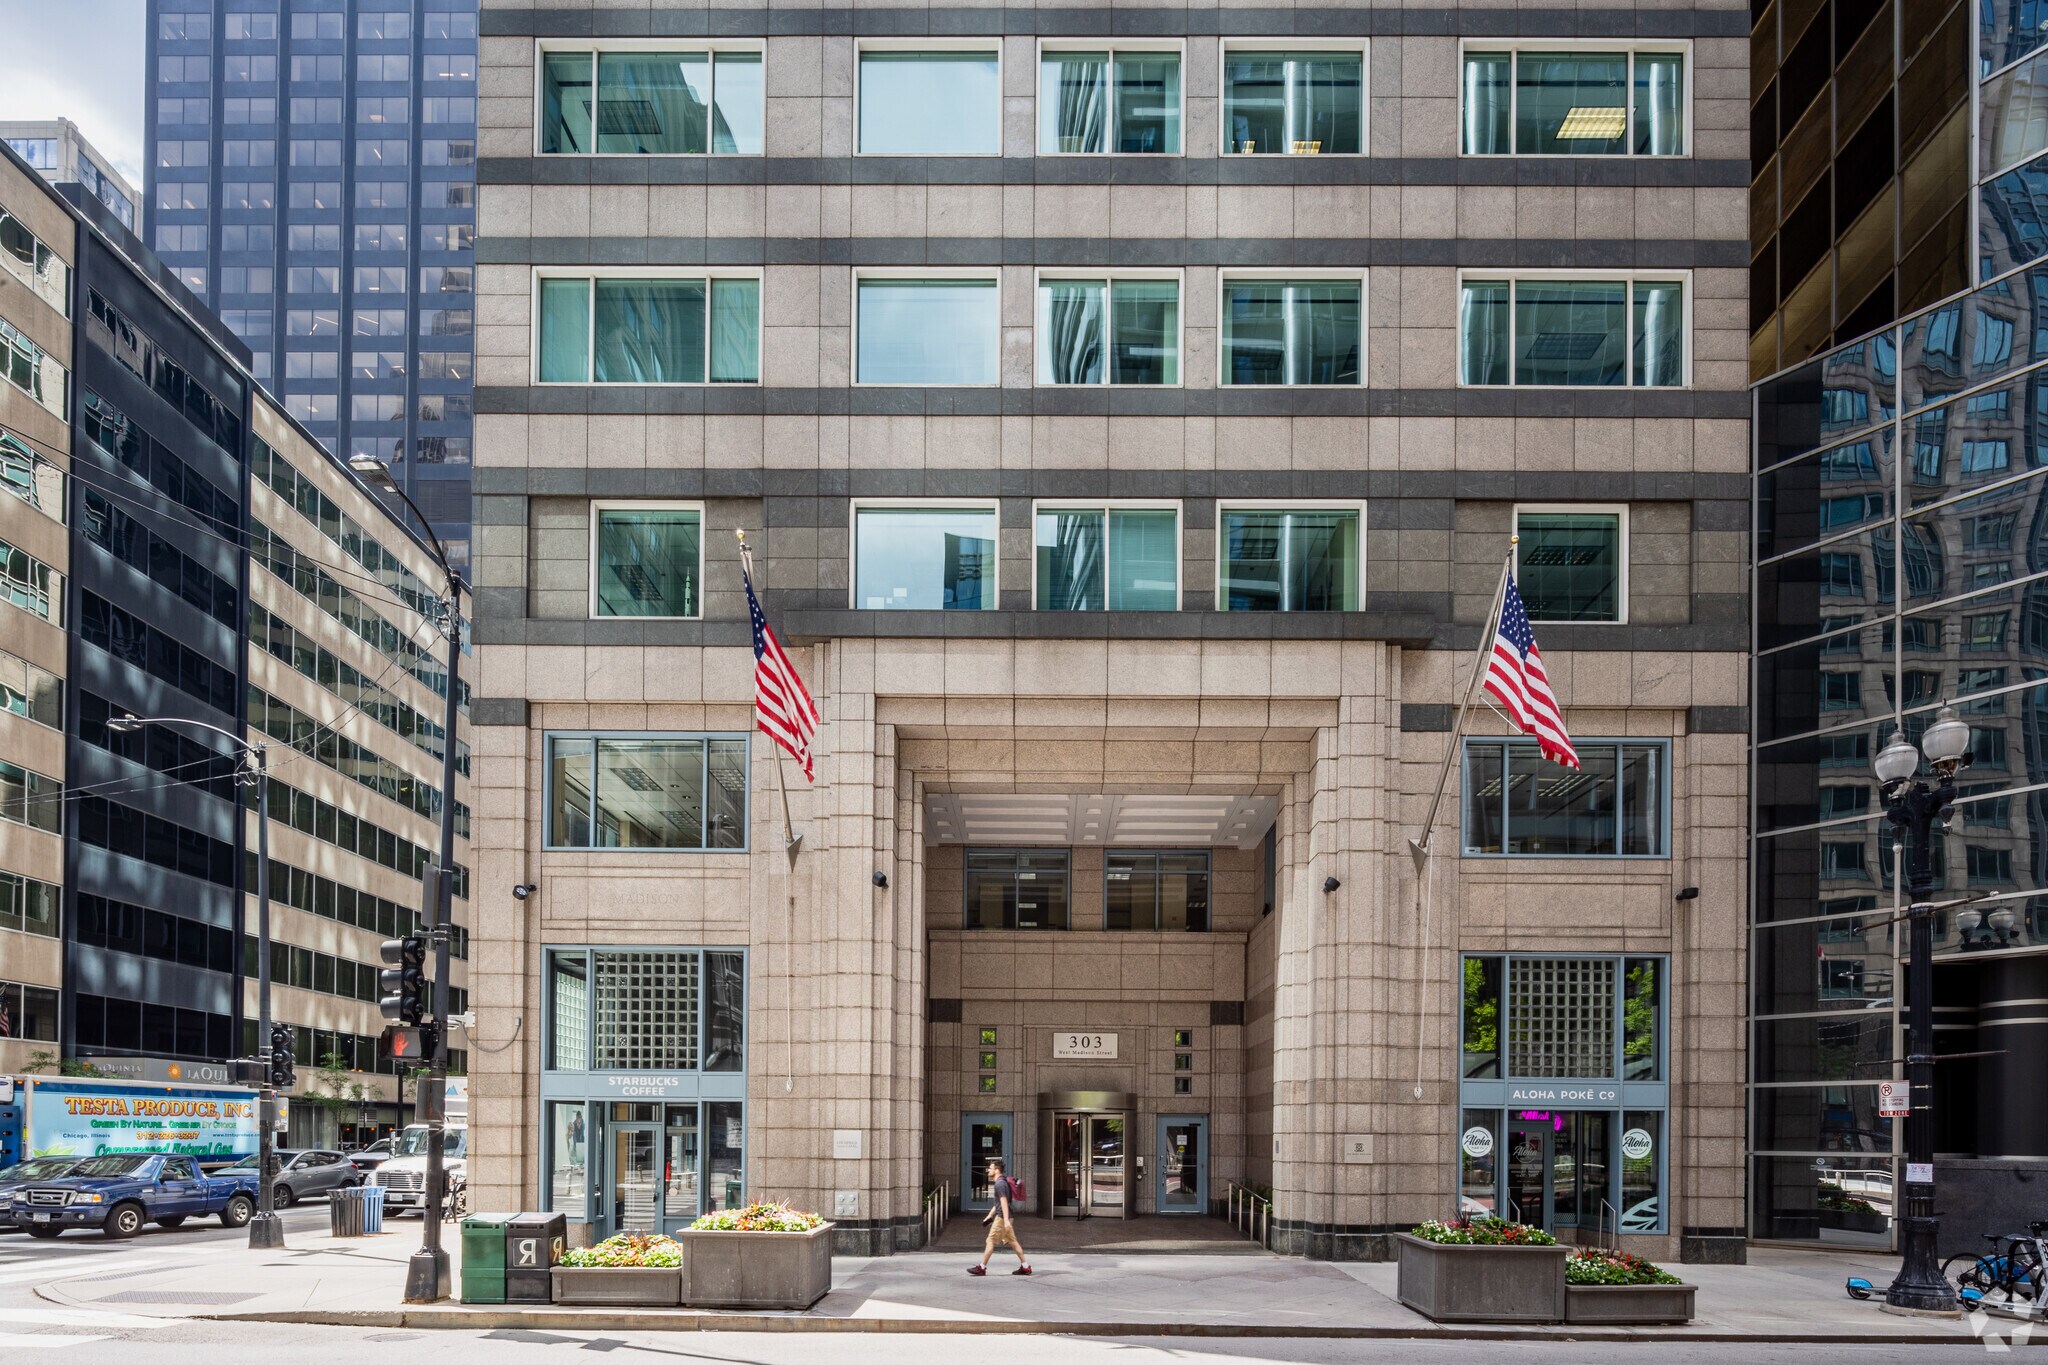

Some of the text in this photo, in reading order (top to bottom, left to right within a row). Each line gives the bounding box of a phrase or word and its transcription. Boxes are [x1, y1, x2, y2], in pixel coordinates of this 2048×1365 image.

[1069, 1036, 1102, 1048] 303
[608, 1076, 679, 1086] STARBUCKS
[622, 1086, 665, 1096] COFFEE
[1512, 1090, 1556, 1099] ALOHA
[65, 1096, 254, 1120] TESTA PRODUCE, INC.
[1464, 1134, 1491, 1146] Aloha
[1622, 1135, 1650, 1148] Aloha
